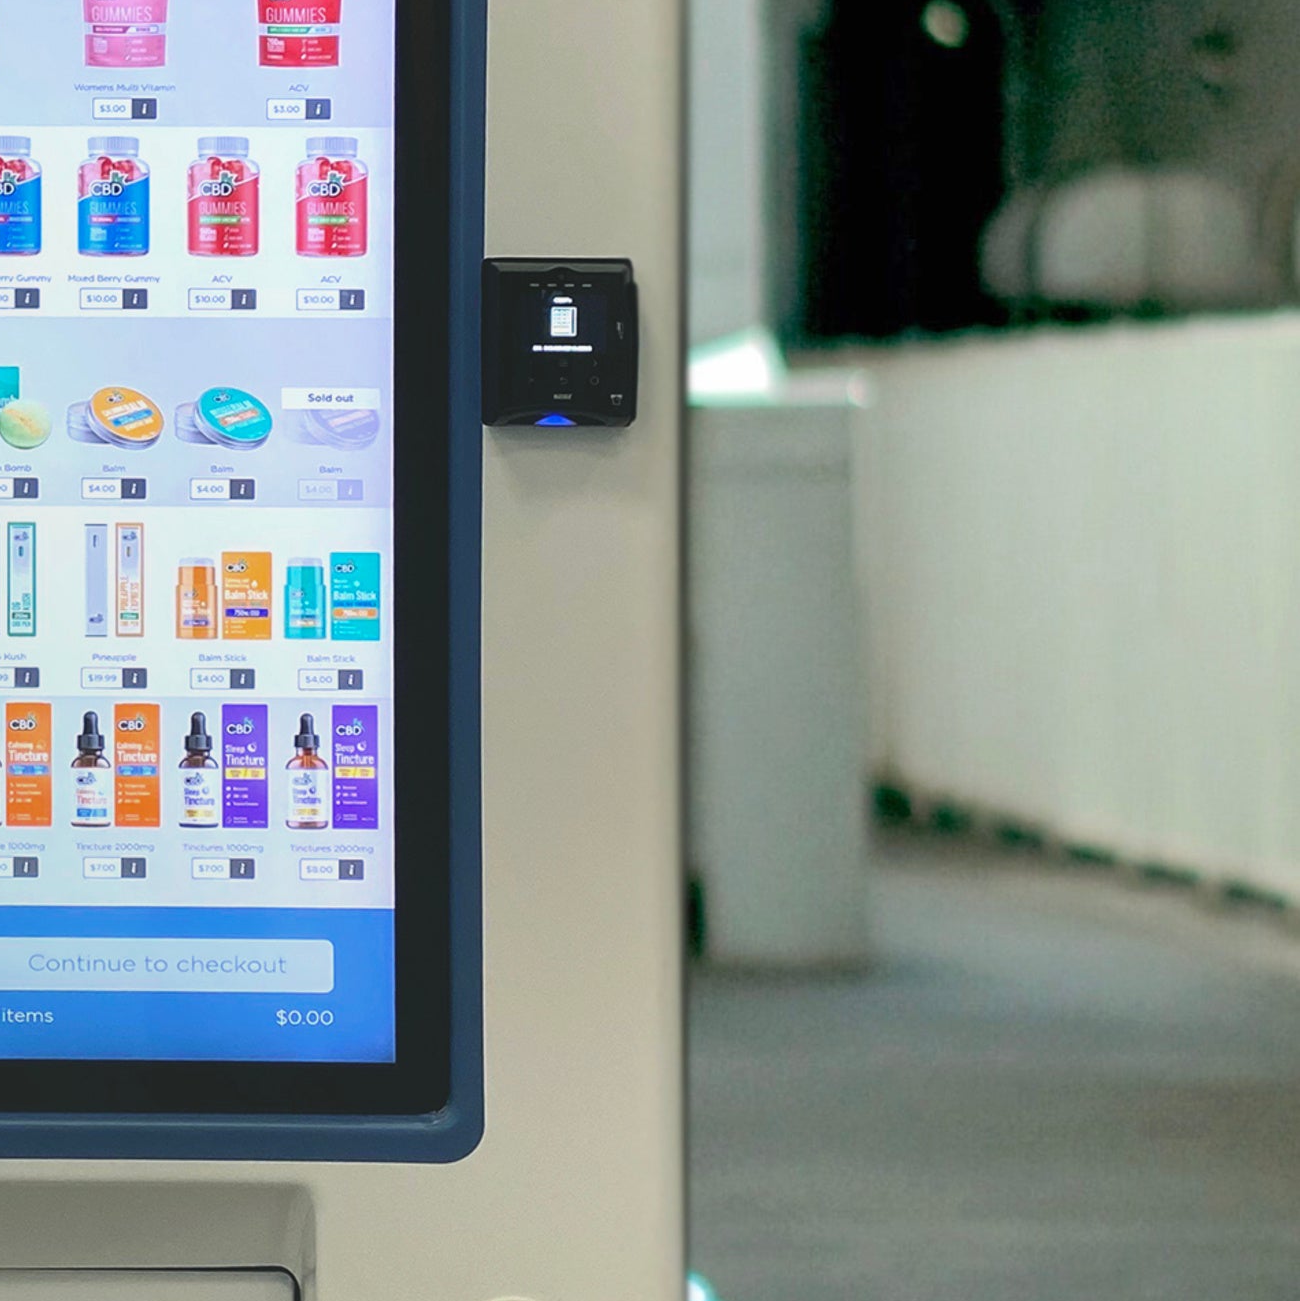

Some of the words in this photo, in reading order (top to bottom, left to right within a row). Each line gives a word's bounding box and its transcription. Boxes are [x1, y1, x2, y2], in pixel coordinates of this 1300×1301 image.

[92, 6, 152, 22] GUMMIES
[266, 7, 326, 22] GUMMIES
[308, 394, 332, 402] Sold
[28, 954, 136, 973] Continue
[144, 957, 168, 973] to
[177, 955, 287, 974] checkout
[2, 1009, 54, 1024] items
[276, 1009, 334, 1026] $0.00
